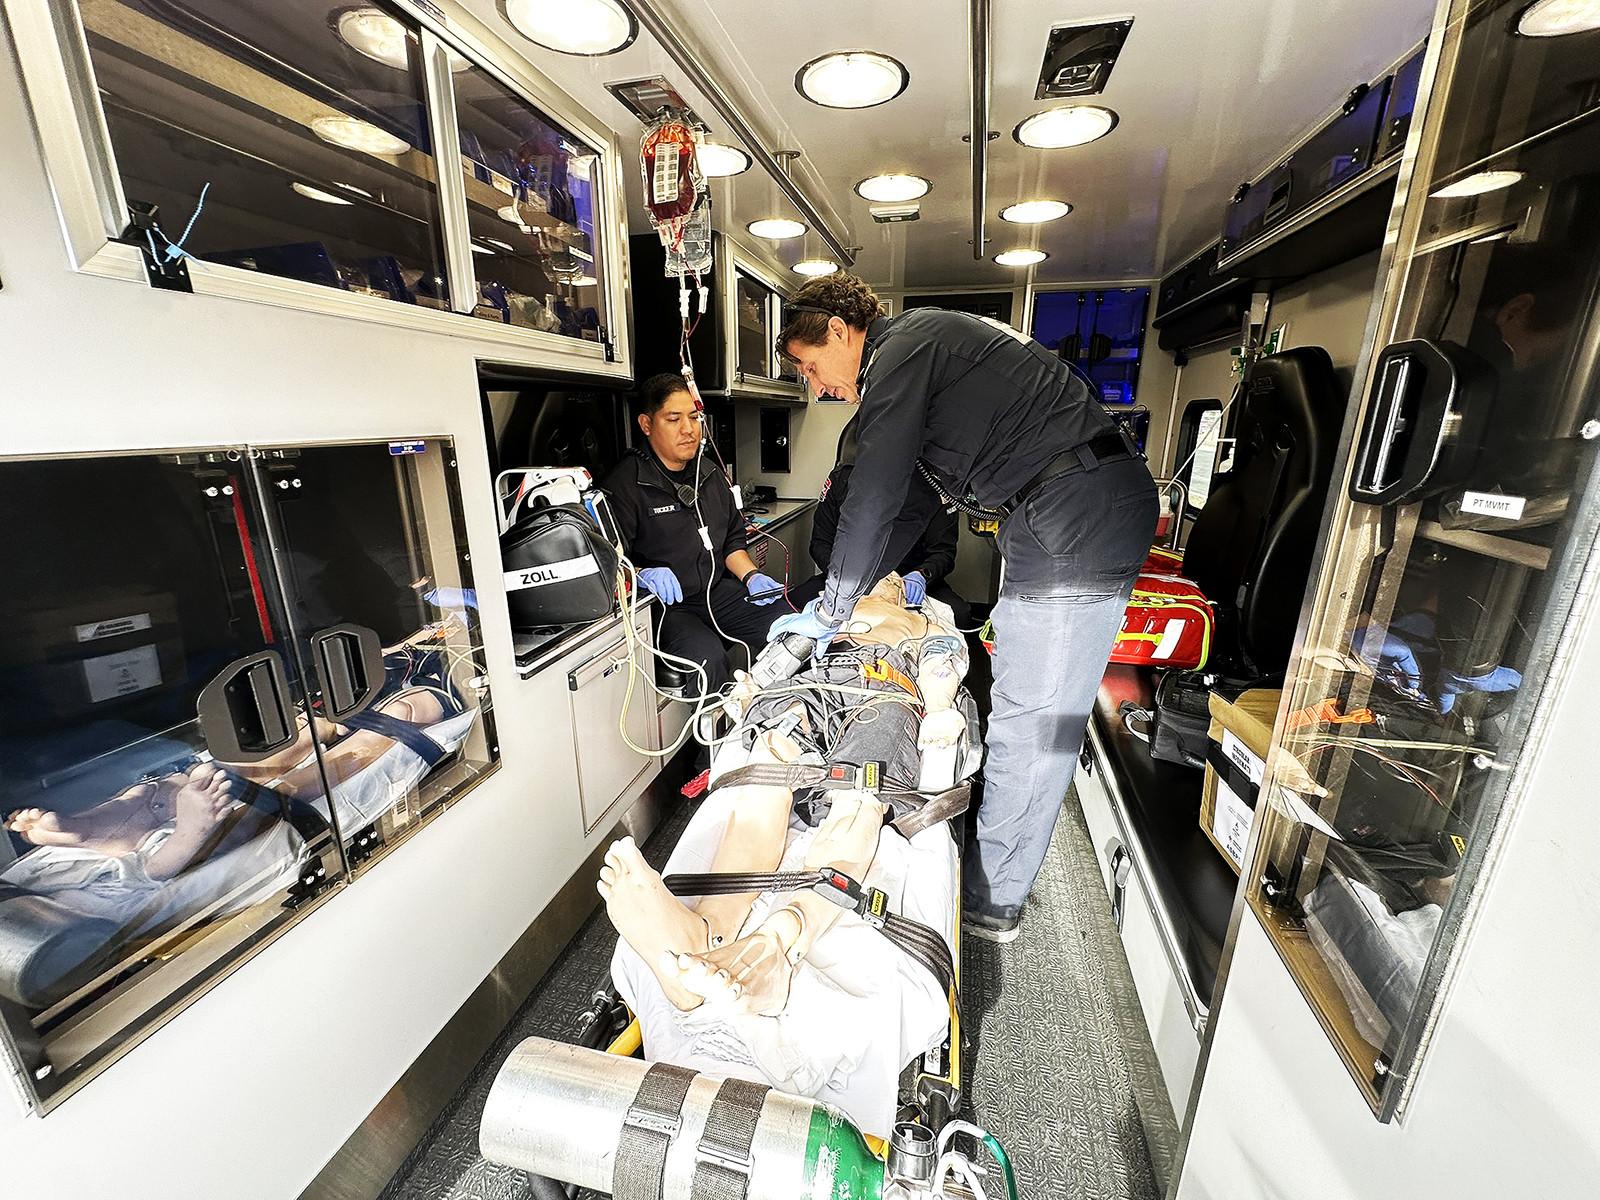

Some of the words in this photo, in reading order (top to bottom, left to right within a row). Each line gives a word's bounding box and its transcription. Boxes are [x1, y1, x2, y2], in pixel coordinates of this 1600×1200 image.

[1473, 498, 1484, 508] PT
[1485, 500, 1510, 511] MVMT
[520, 569, 558, 585] ZOLL
